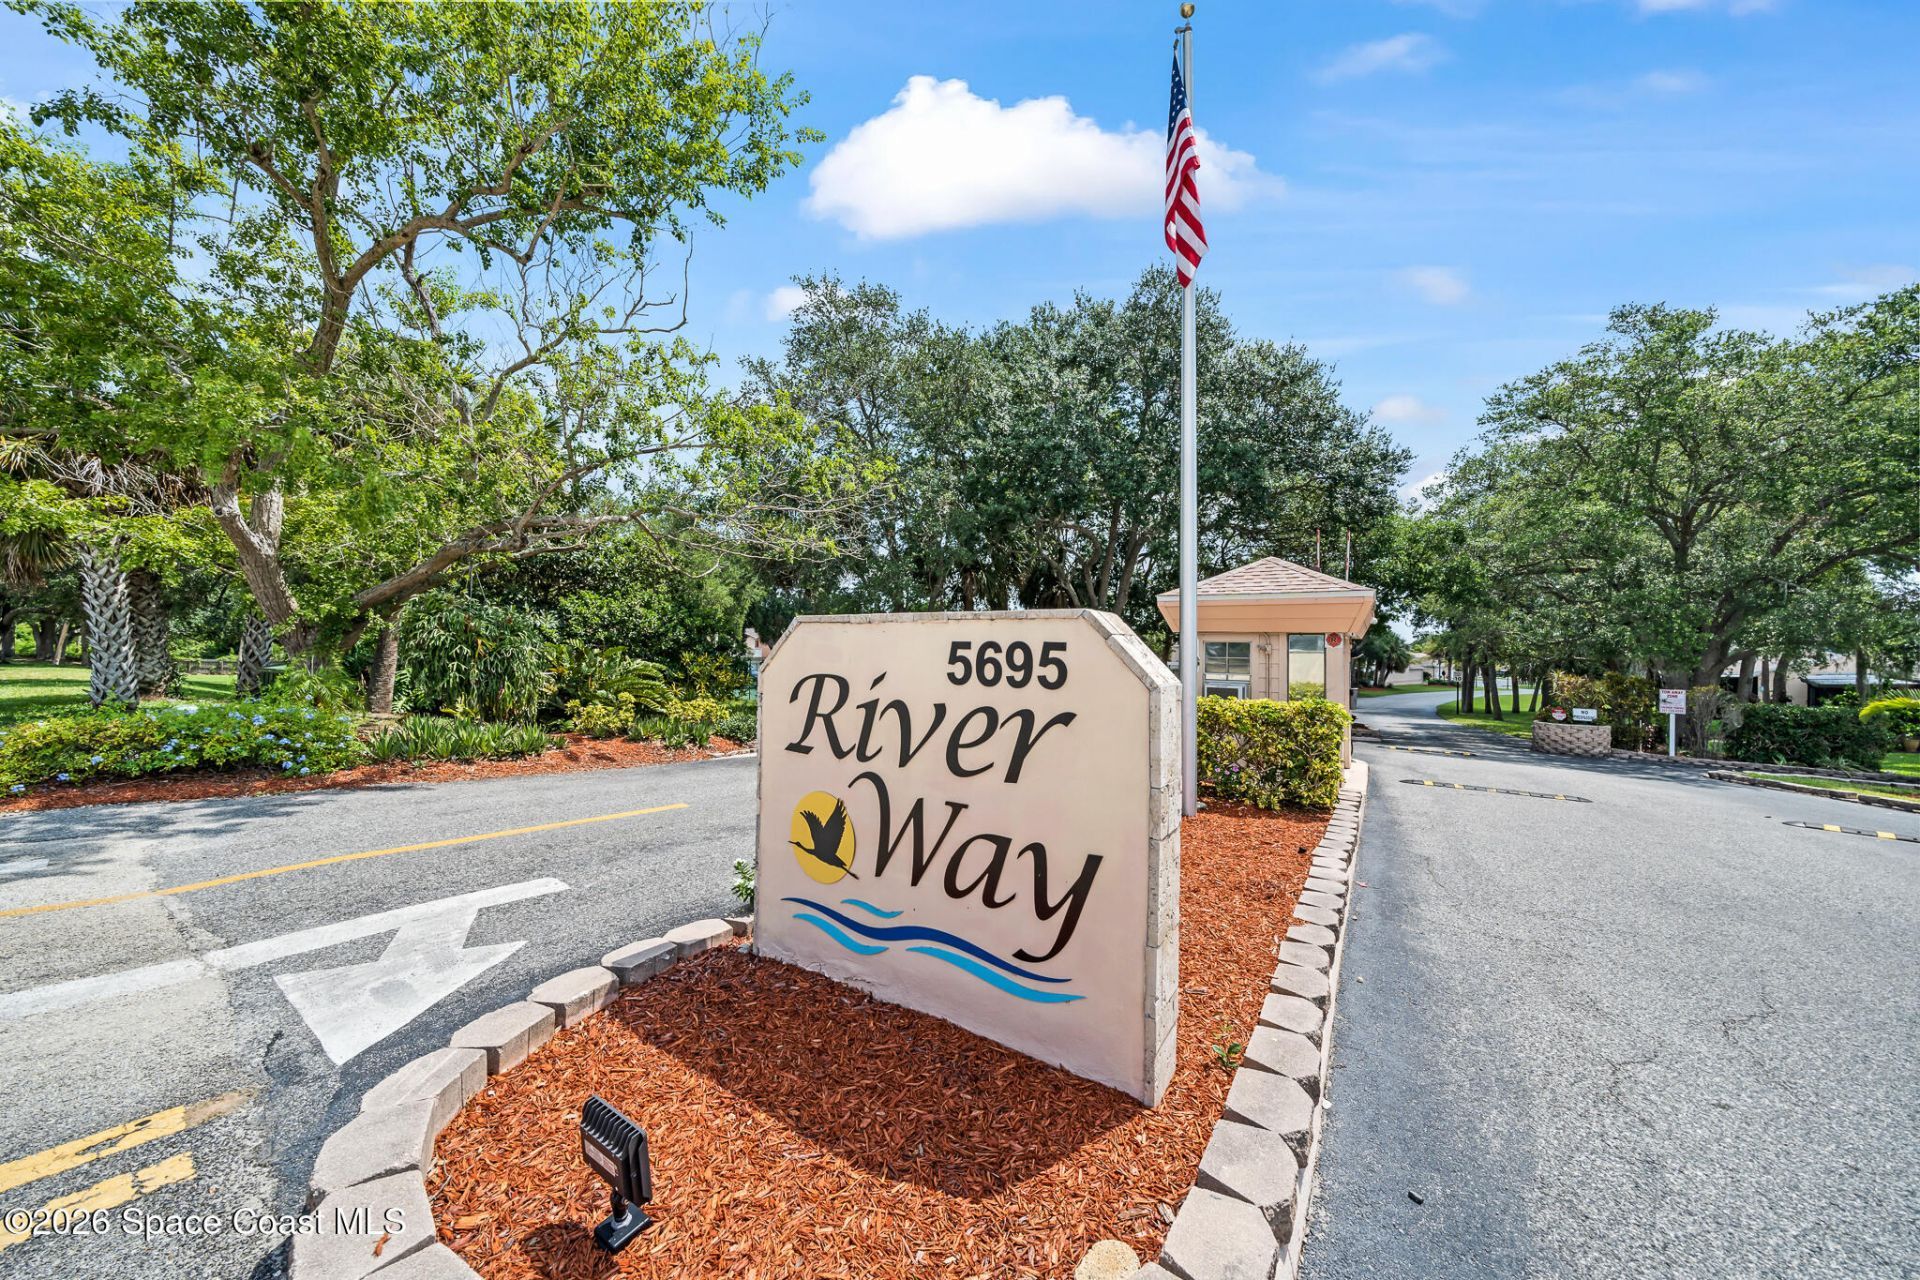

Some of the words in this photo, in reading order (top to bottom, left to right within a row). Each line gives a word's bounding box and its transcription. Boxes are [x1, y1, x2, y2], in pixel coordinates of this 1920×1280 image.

[946, 640, 1068, 691] 5695
[784, 671, 1077, 784] River
[847, 771, 1104, 964] Way
